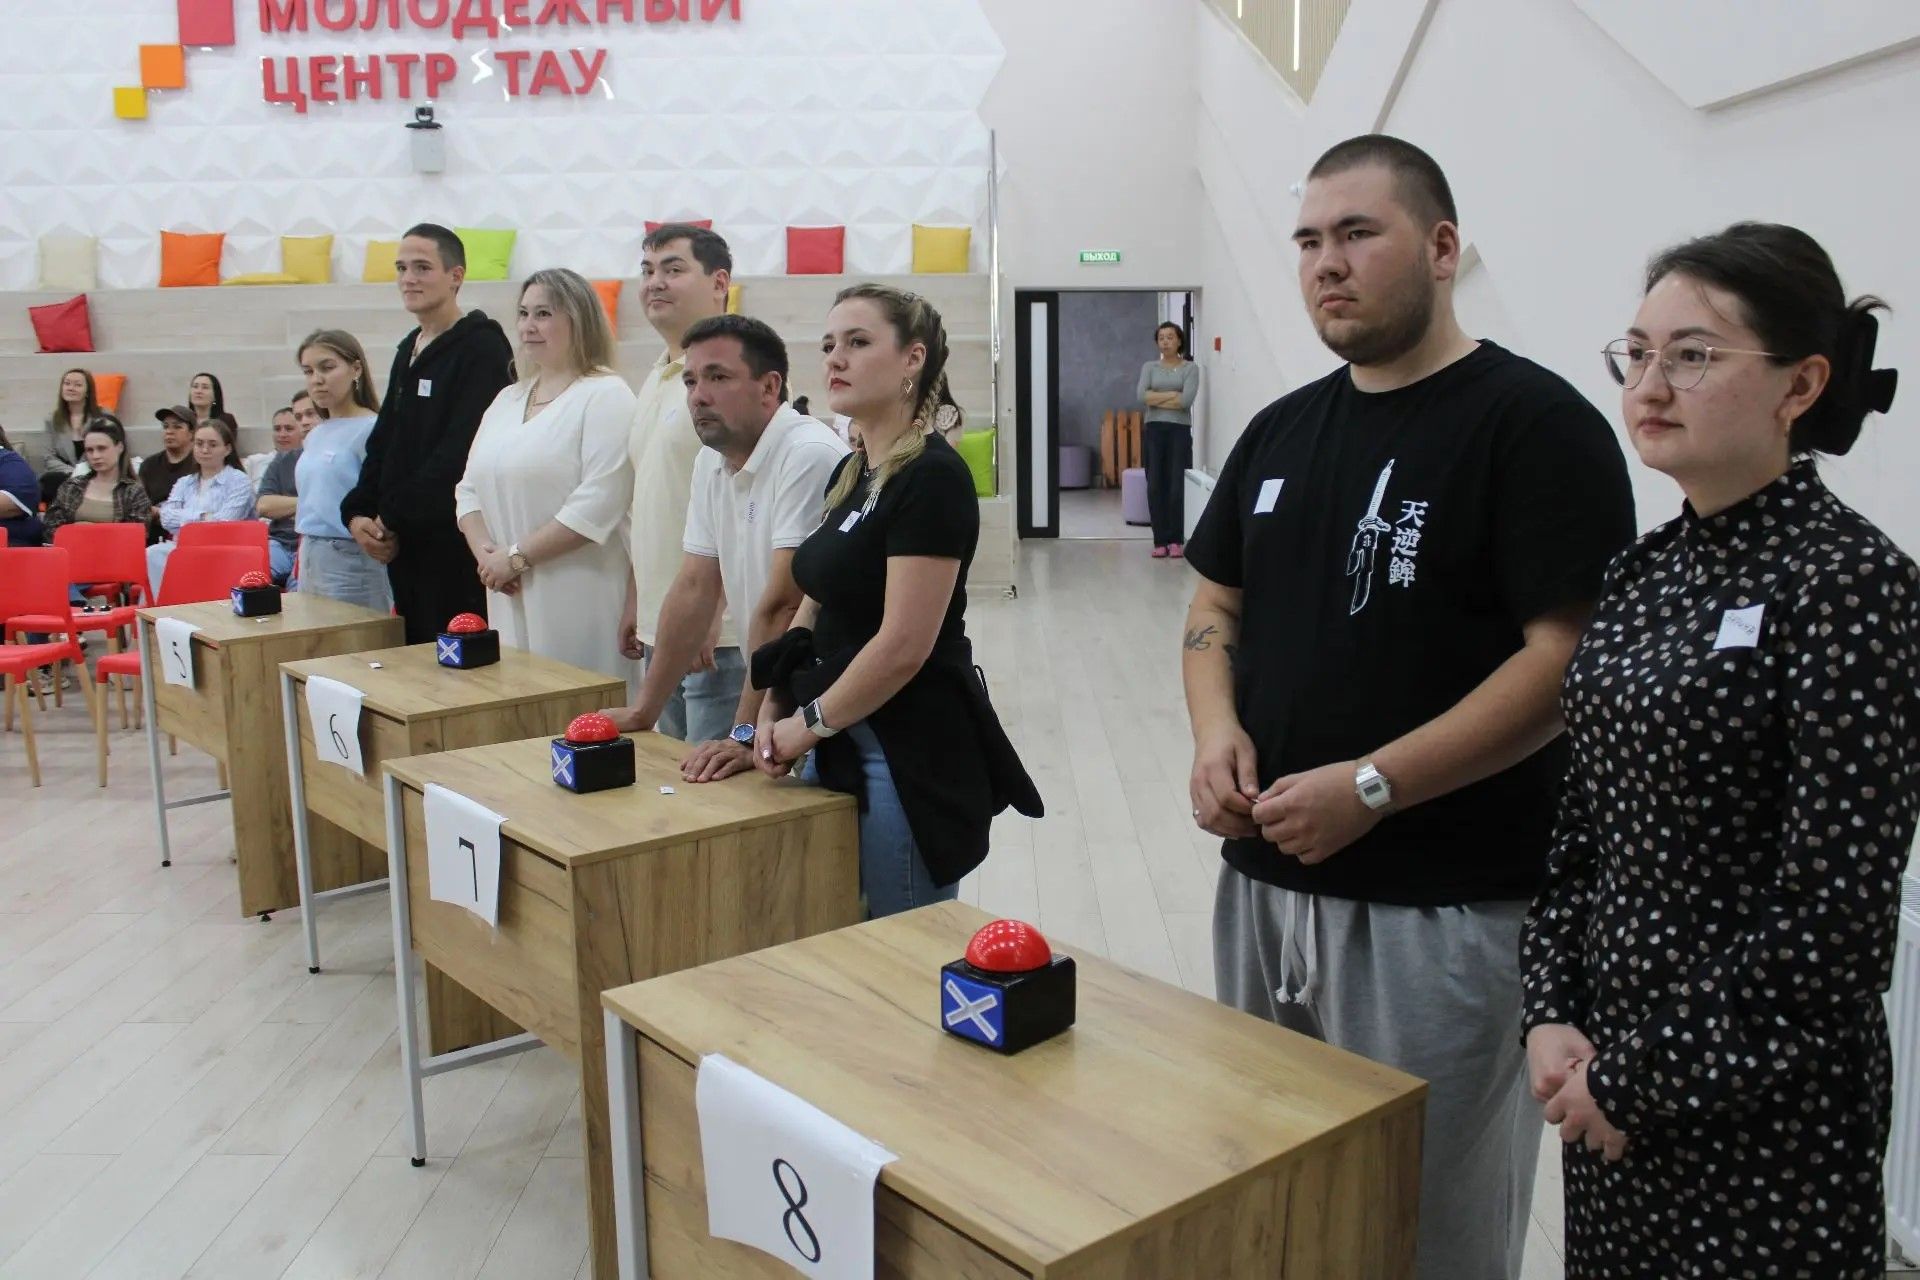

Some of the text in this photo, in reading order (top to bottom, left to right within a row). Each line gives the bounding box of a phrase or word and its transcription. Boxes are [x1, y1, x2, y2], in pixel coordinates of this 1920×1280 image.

[262, 48, 608, 113] ЦЕНТР ТАУ
[1083, 252, 1118, 262] ВЫХОД
[1389, 500, 1429, 588] 天逆鉾
[172, 641, 187, 678] 5
[329, 713, 349, 760] 6
[458, 836, 479, 903] 7
[772, 1158, 821, 1263] 8
